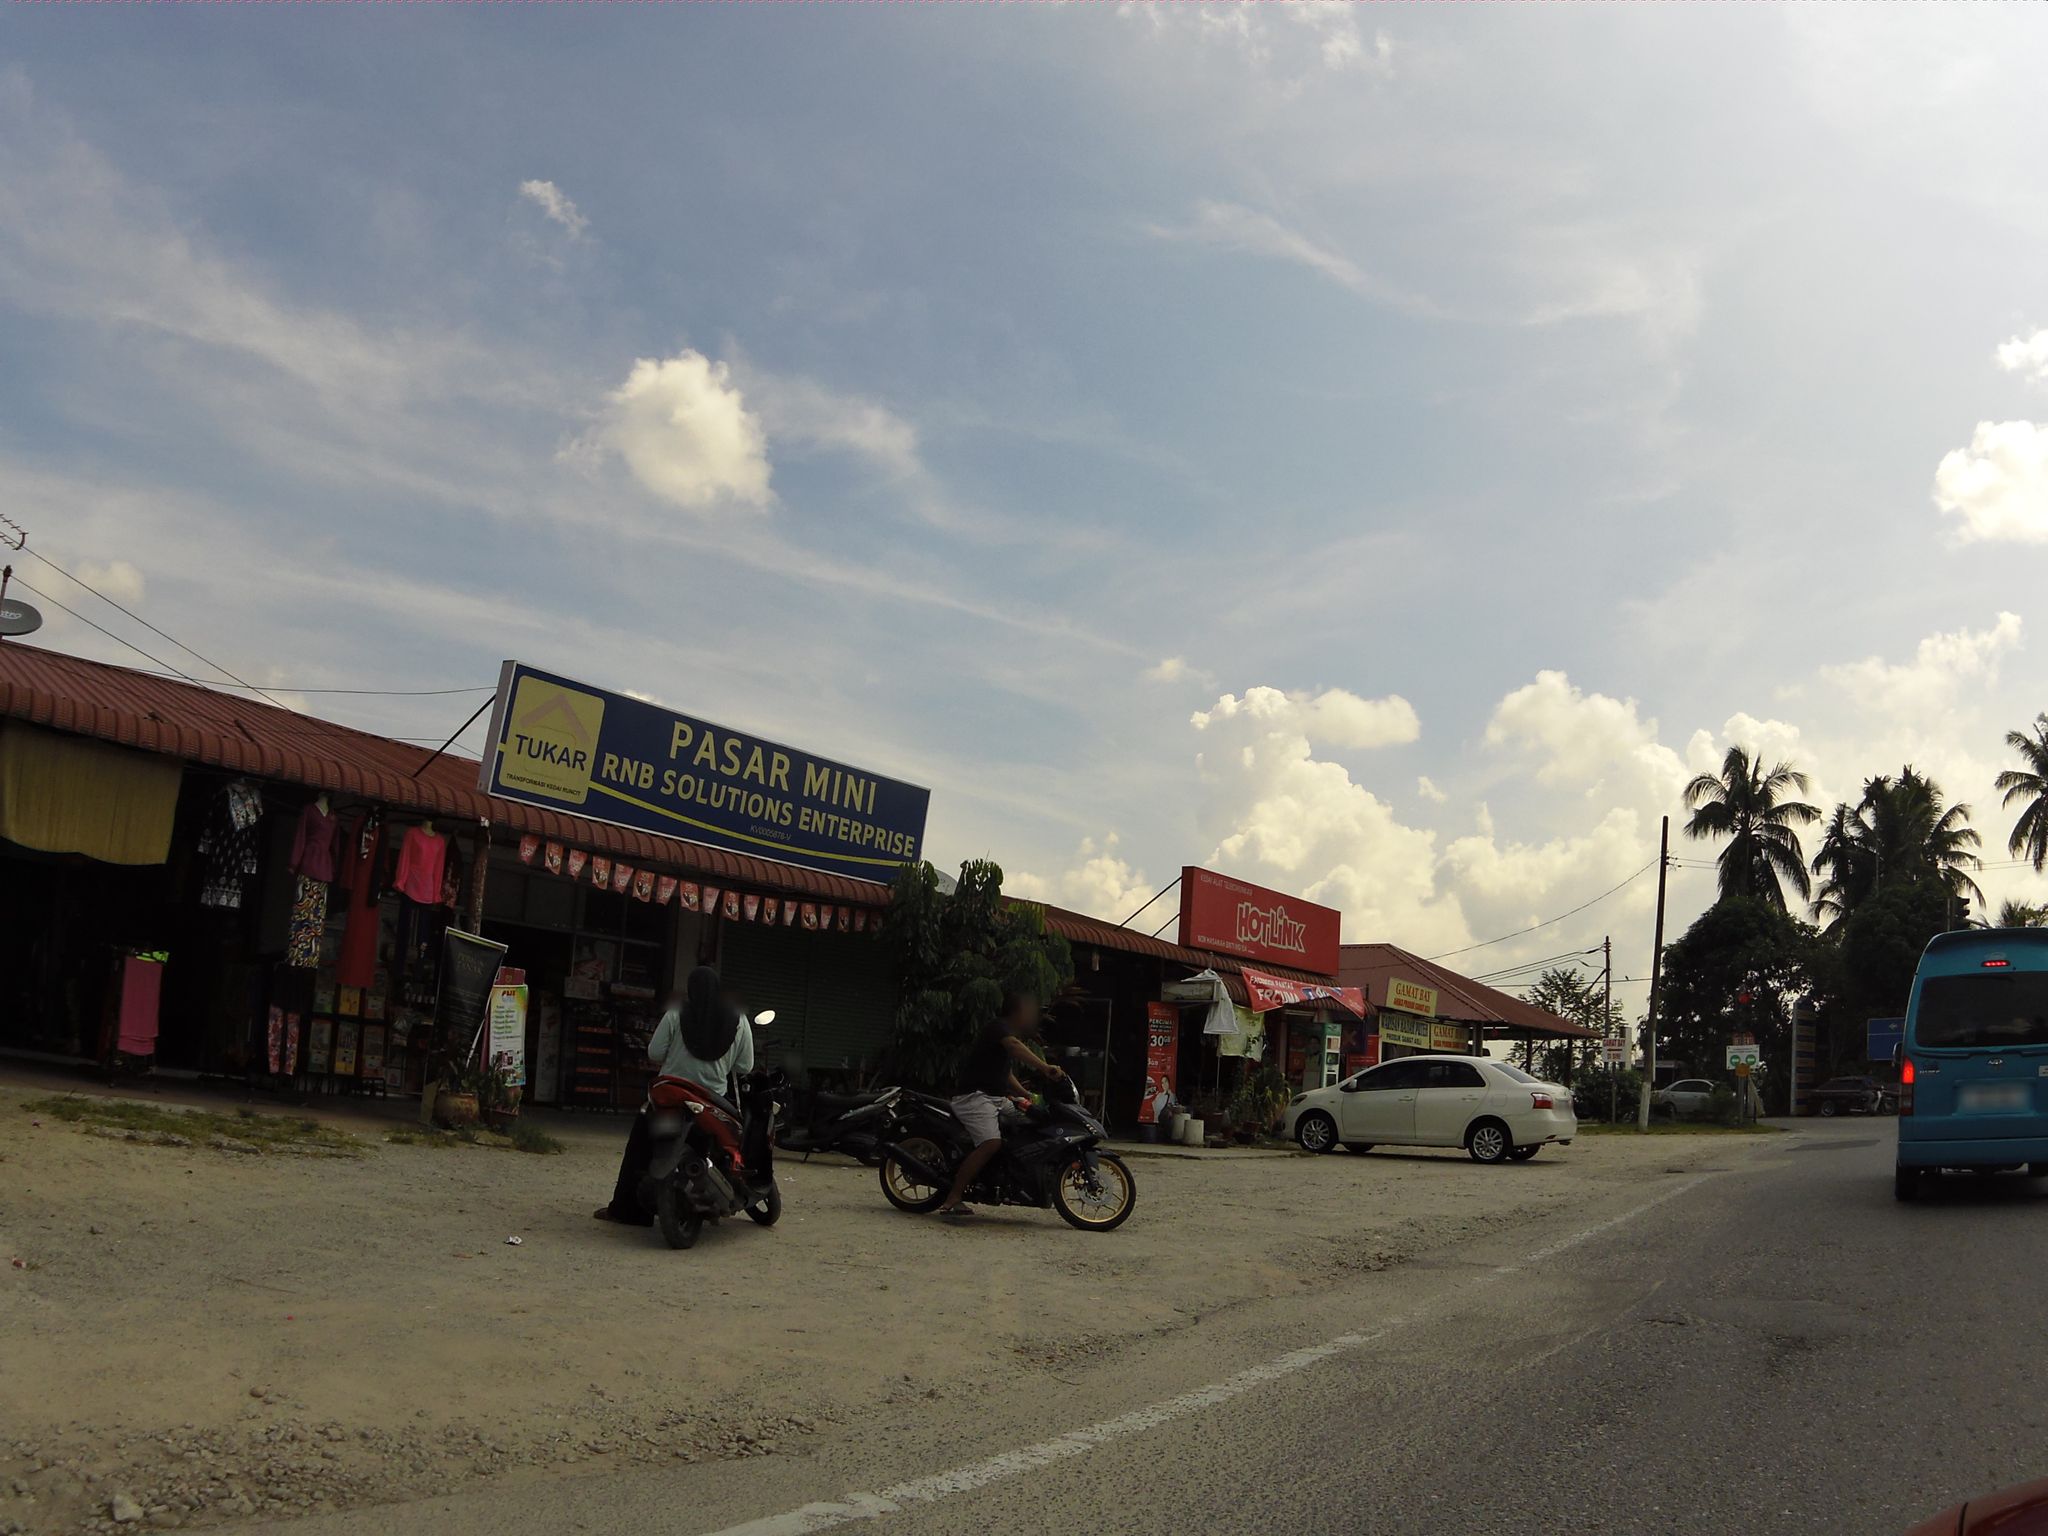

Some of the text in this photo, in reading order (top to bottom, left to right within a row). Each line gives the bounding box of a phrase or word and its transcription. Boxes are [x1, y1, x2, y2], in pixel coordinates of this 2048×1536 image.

[515, 734, 587, 771] TUKAR
[669, 720, 878, 815] PASAR MINI
[601, 753, 915, 858] RNB SOLUTIONS ENTERPRISE
[1395, 983, 1432, 1002] GAMAT BAY
